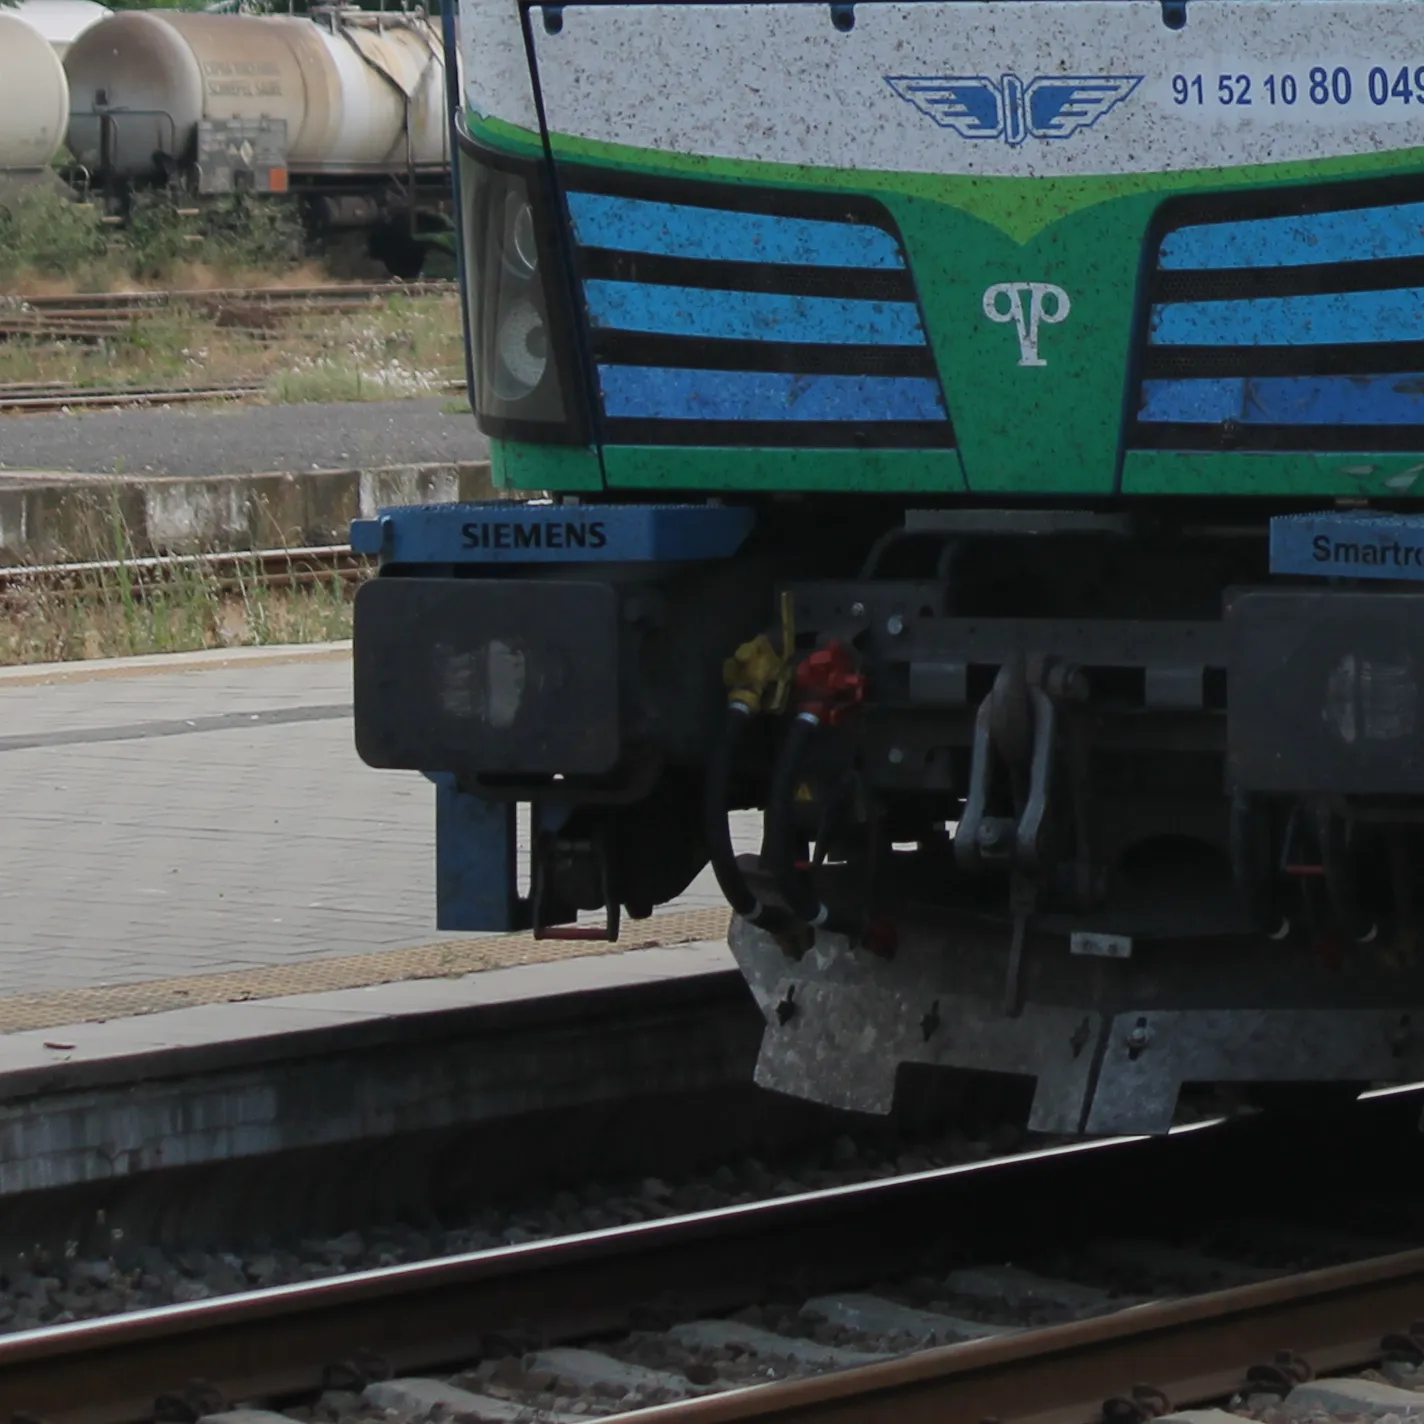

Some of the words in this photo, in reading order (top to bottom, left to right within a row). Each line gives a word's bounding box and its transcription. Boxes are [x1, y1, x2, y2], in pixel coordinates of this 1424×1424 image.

[1171, 73, 1204, 105] 91
[1217, 74, 1252, 105] 52
[1263, 74, 1298, 105] 10
[1308, 66, 1353, 105] 80
[461, 522, 607, 549] SIEMENS
